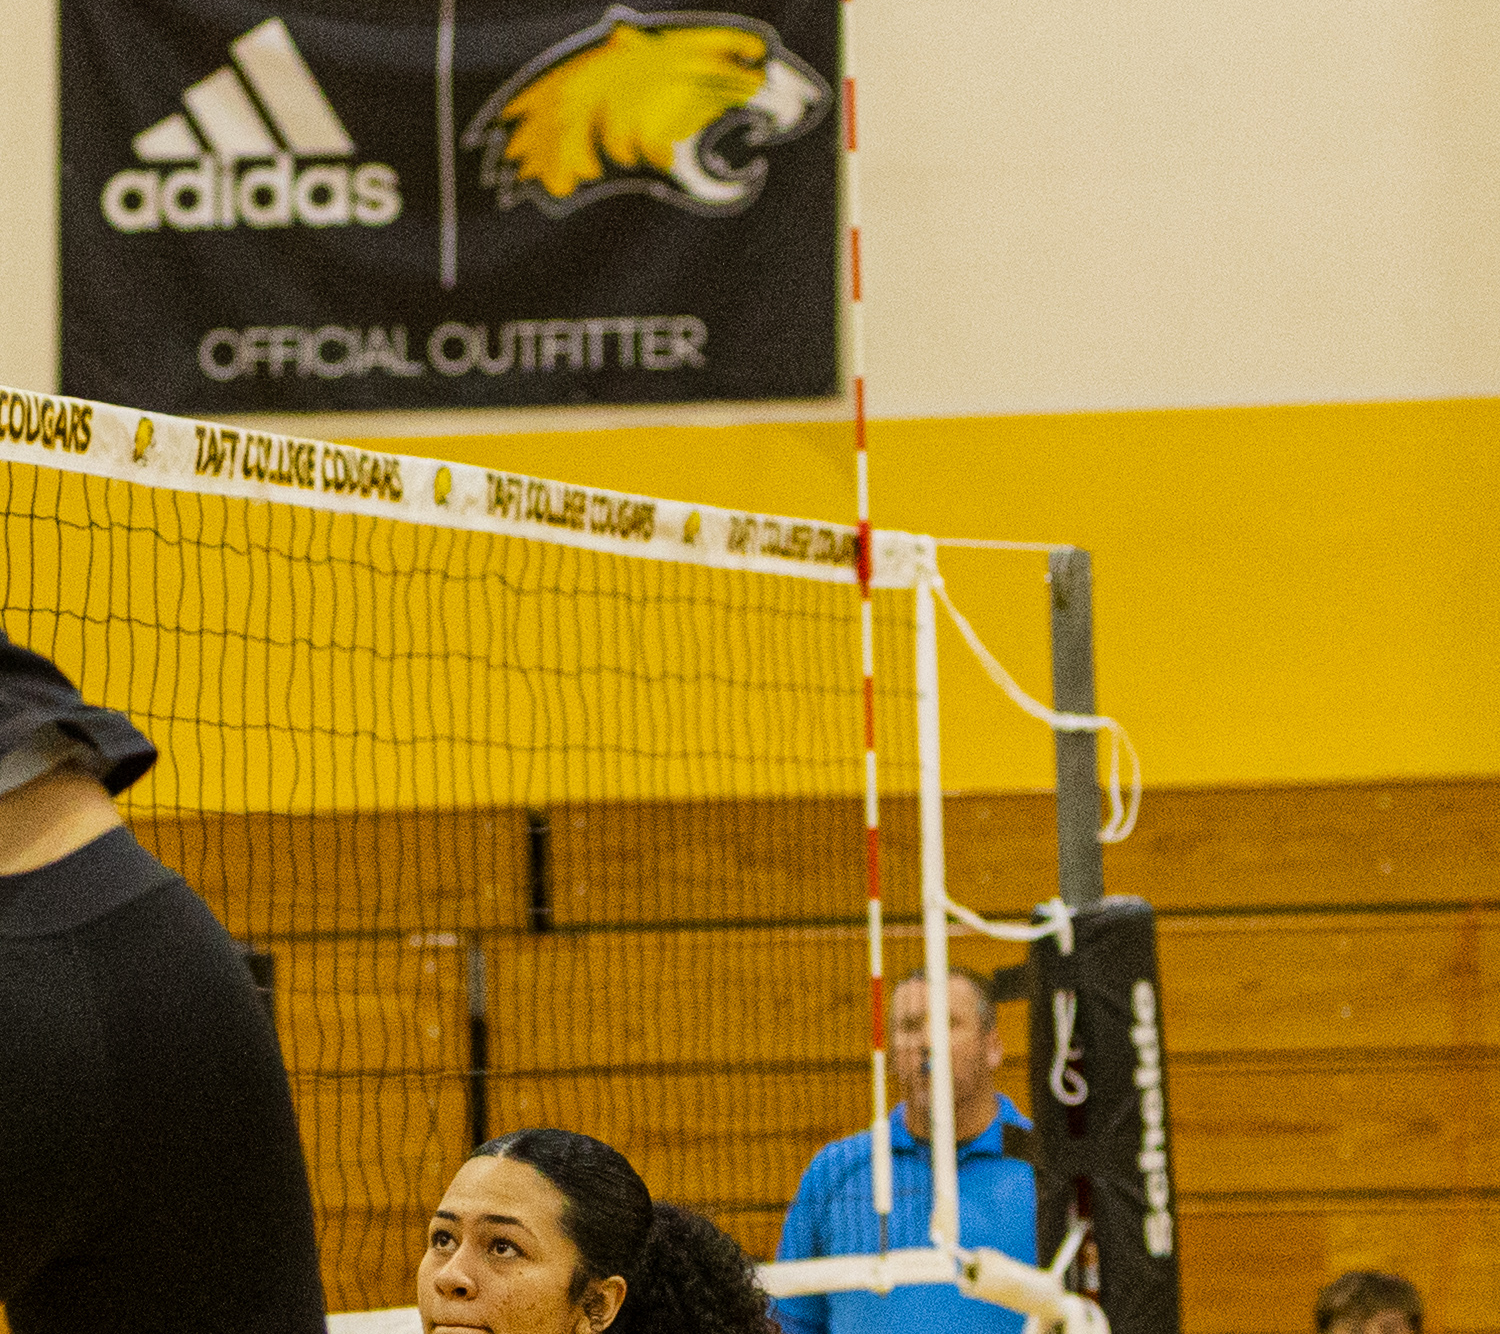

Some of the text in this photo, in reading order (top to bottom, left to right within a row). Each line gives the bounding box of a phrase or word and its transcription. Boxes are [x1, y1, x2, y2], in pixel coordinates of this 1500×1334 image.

[100, 159, 403, 234] adidas
[199, 314, 709, 383] OFFICIAL OUTFITTER
